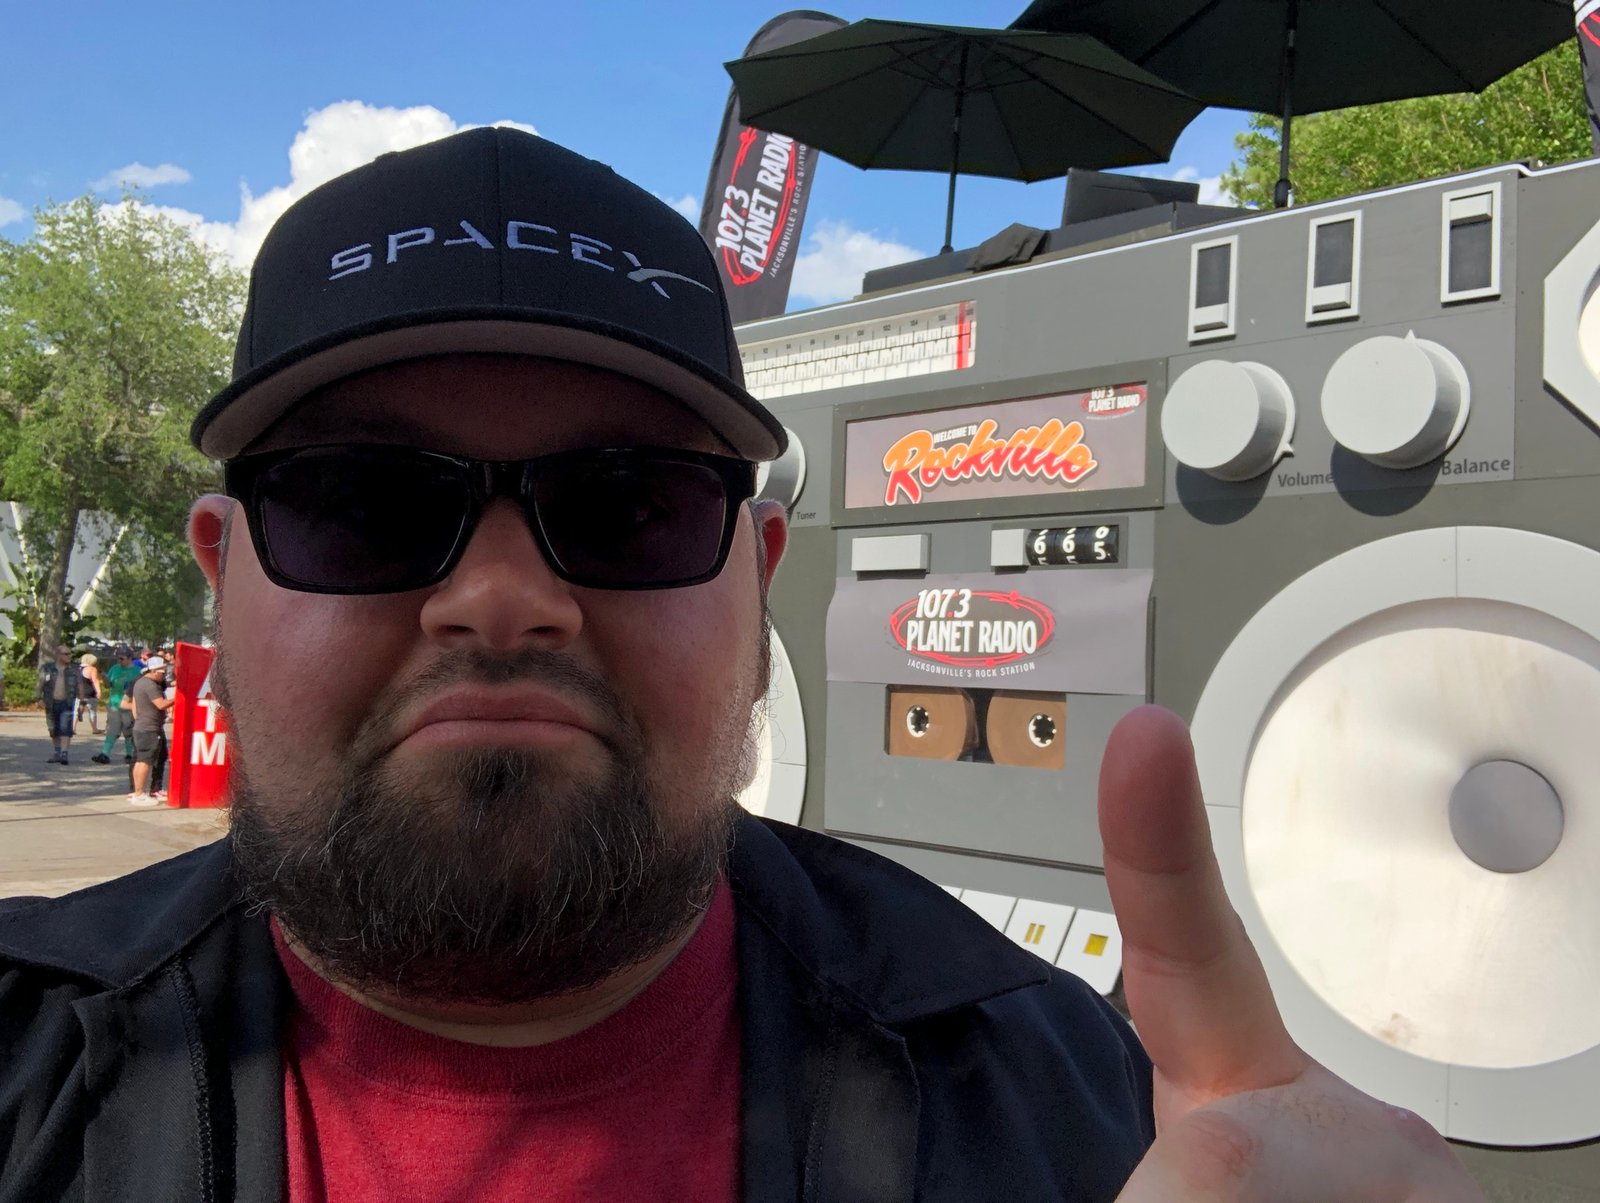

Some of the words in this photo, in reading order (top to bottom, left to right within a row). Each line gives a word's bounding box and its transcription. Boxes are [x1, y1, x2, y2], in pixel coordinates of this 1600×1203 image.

[715, 185, 750, 253] 107.3
[740, 188, 779, 273] PLANET
[328, 219, 714, 299] SPACEX
[1088, 397, 1116, 412] PLANET
[933, 426, 967, 443] WELCOME
[883, 418, 1097, 506] Rockville
[1441, 458, 1511, 476] Balance
[1277, 472, 1335, 488] Volume
[915, 588, 972, 619] 107.3
[906, 620, 974, 653] PLANET
[977, 620, 1037, 654] RADIO
[907, 658, 972, 678] JACKSONVILLE'S
[975, 668, 997, 678] ROCK
[1000, 661, 1035, 676] STATION
